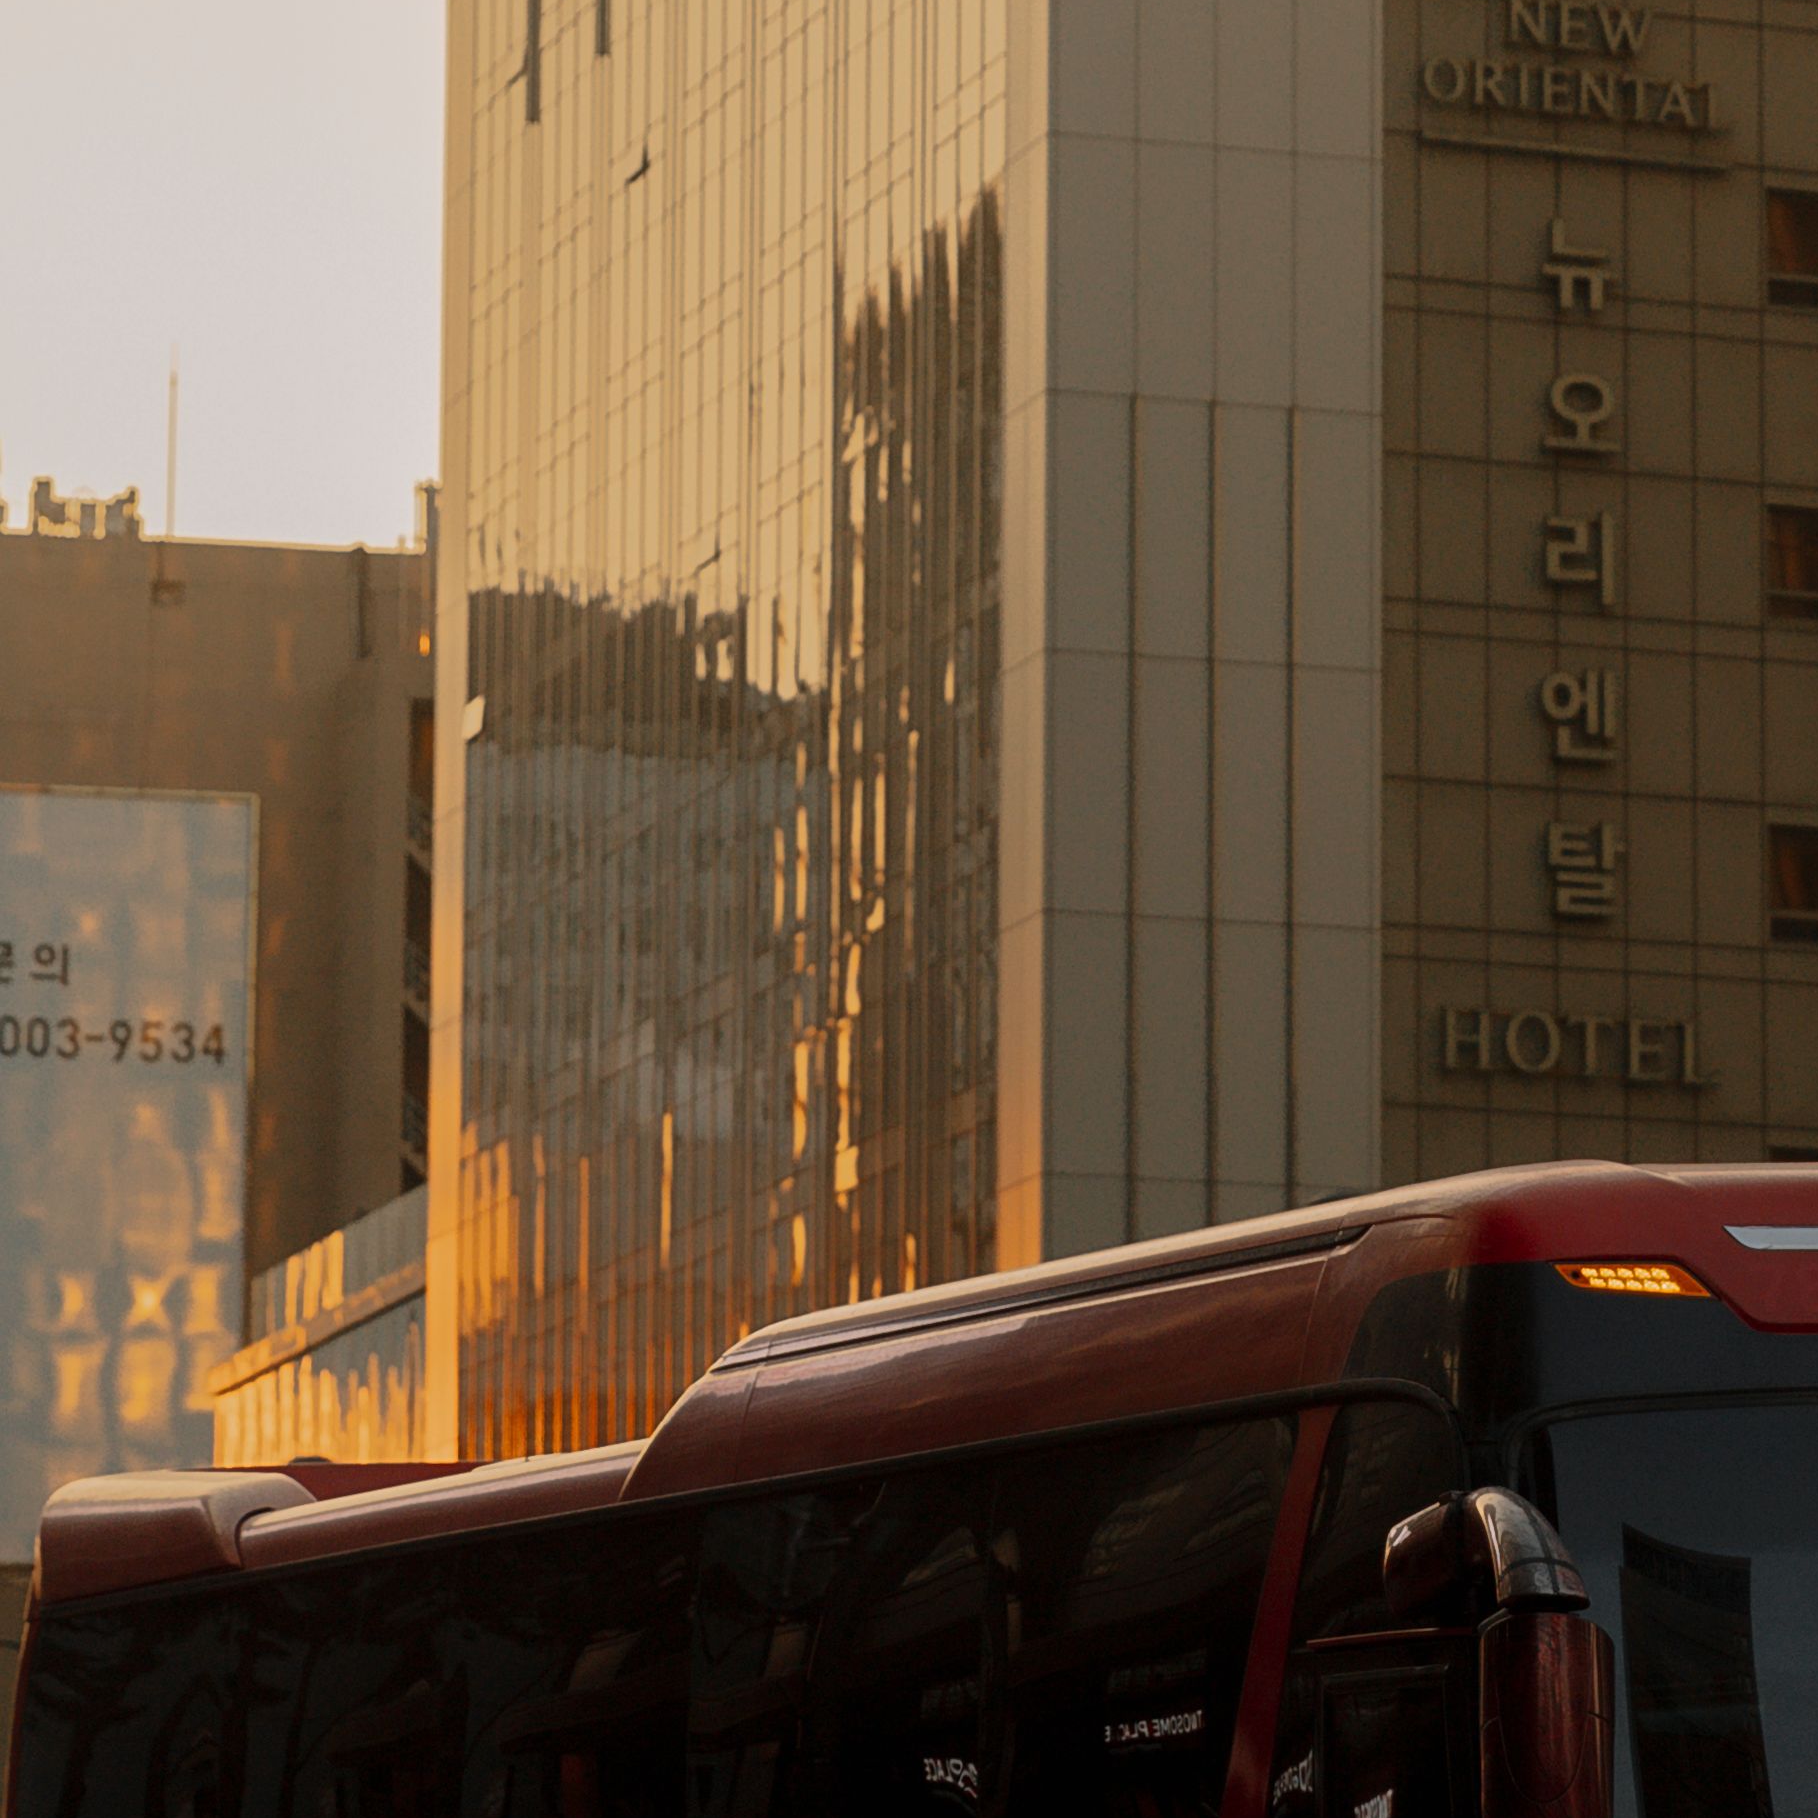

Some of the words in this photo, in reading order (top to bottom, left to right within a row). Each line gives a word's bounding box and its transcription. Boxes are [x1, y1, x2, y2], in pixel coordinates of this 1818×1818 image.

[1423, 58, 1726, 130] ORIENTAL
[1541, 216, 1626, 918] 뉴오리엔탈
[1442, 1007, 1716, 1085] HOTEL
